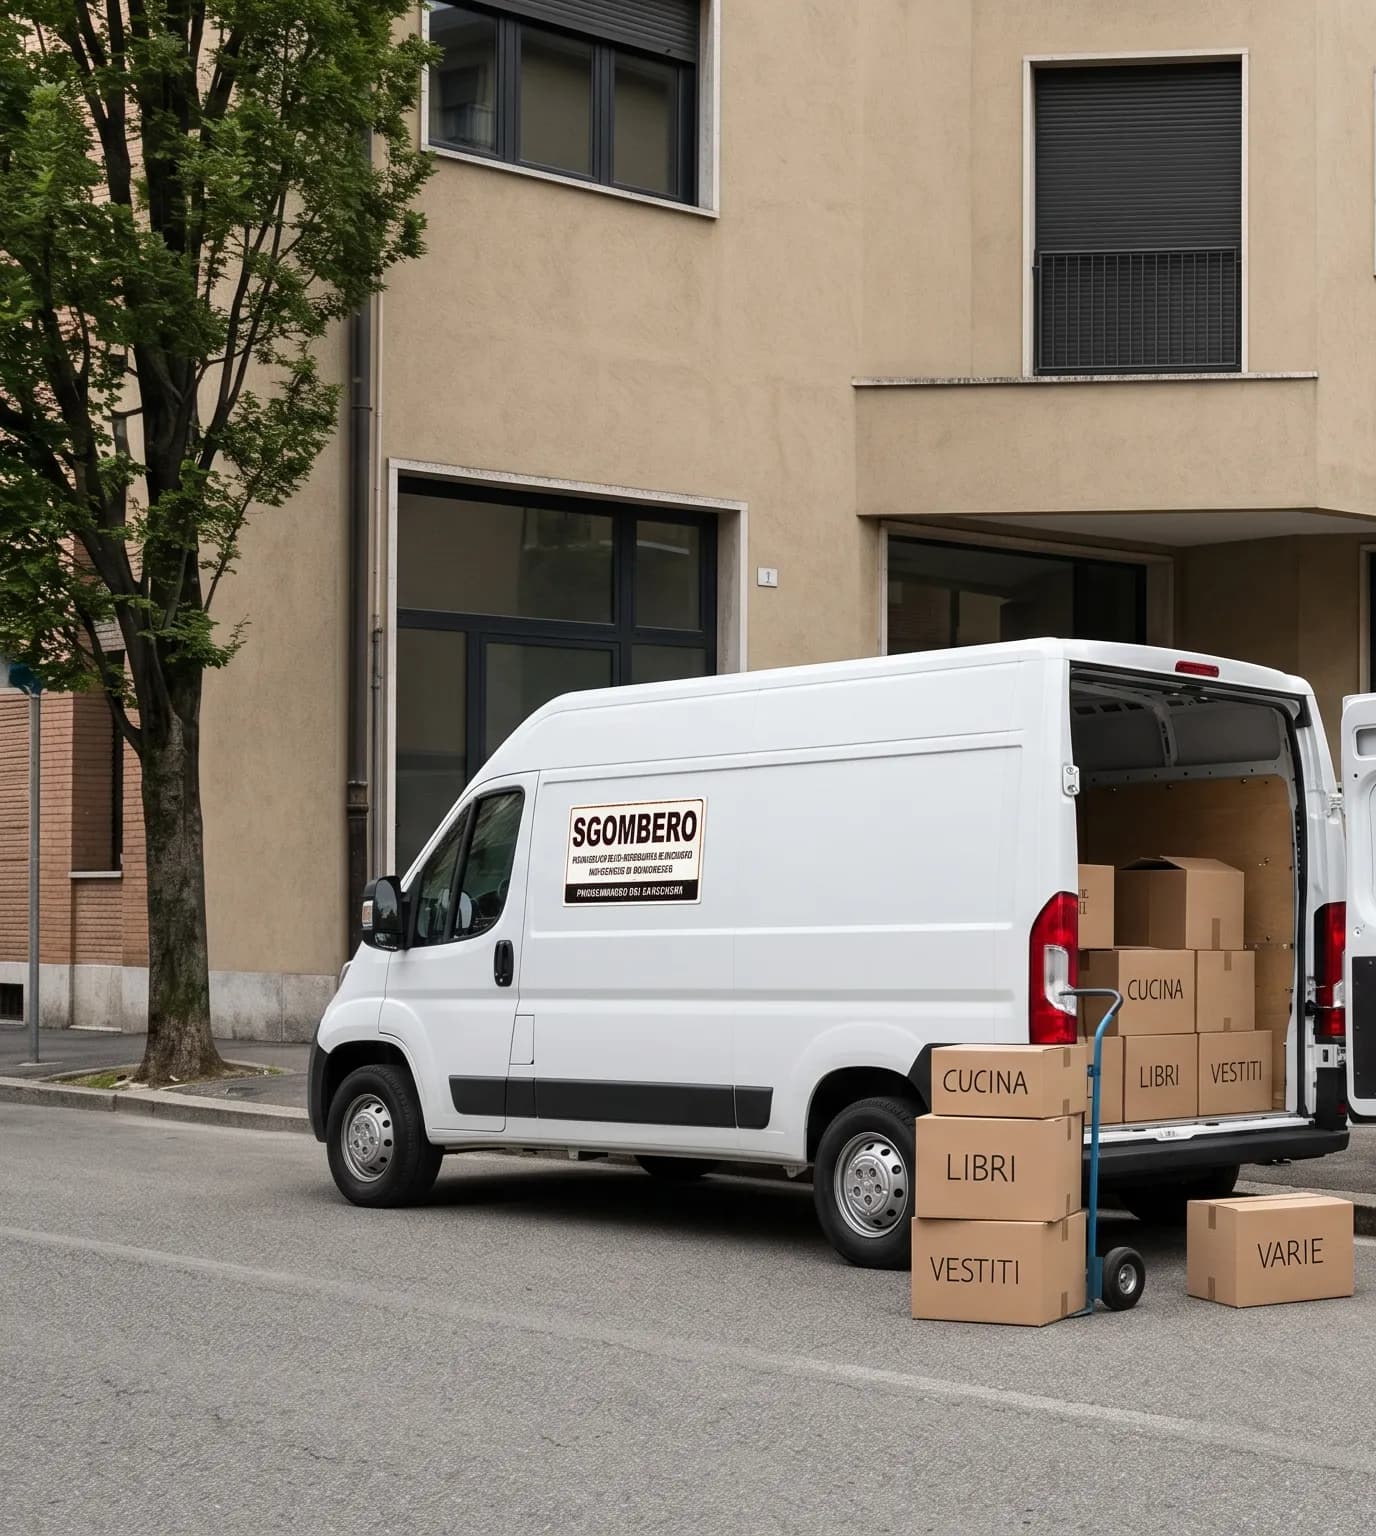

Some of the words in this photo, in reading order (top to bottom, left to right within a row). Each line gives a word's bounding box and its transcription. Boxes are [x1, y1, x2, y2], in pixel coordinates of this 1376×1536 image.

[572, 810, 698, 848] SGOMBERO
[1127, 978, 1184, 1001] CUCINA
[942, 1069, 1029, 1095] CUCINA
[1140, 1063, 1179, 1089] LIBRI
[1210, 1060, 1262, 1084] VESTITI
[947, 1153, 1015, 1183] LIBRI
[1257, 1237, 1324, 1269] VARIE
[929, 1256, 1019, 1285] VESTITI
